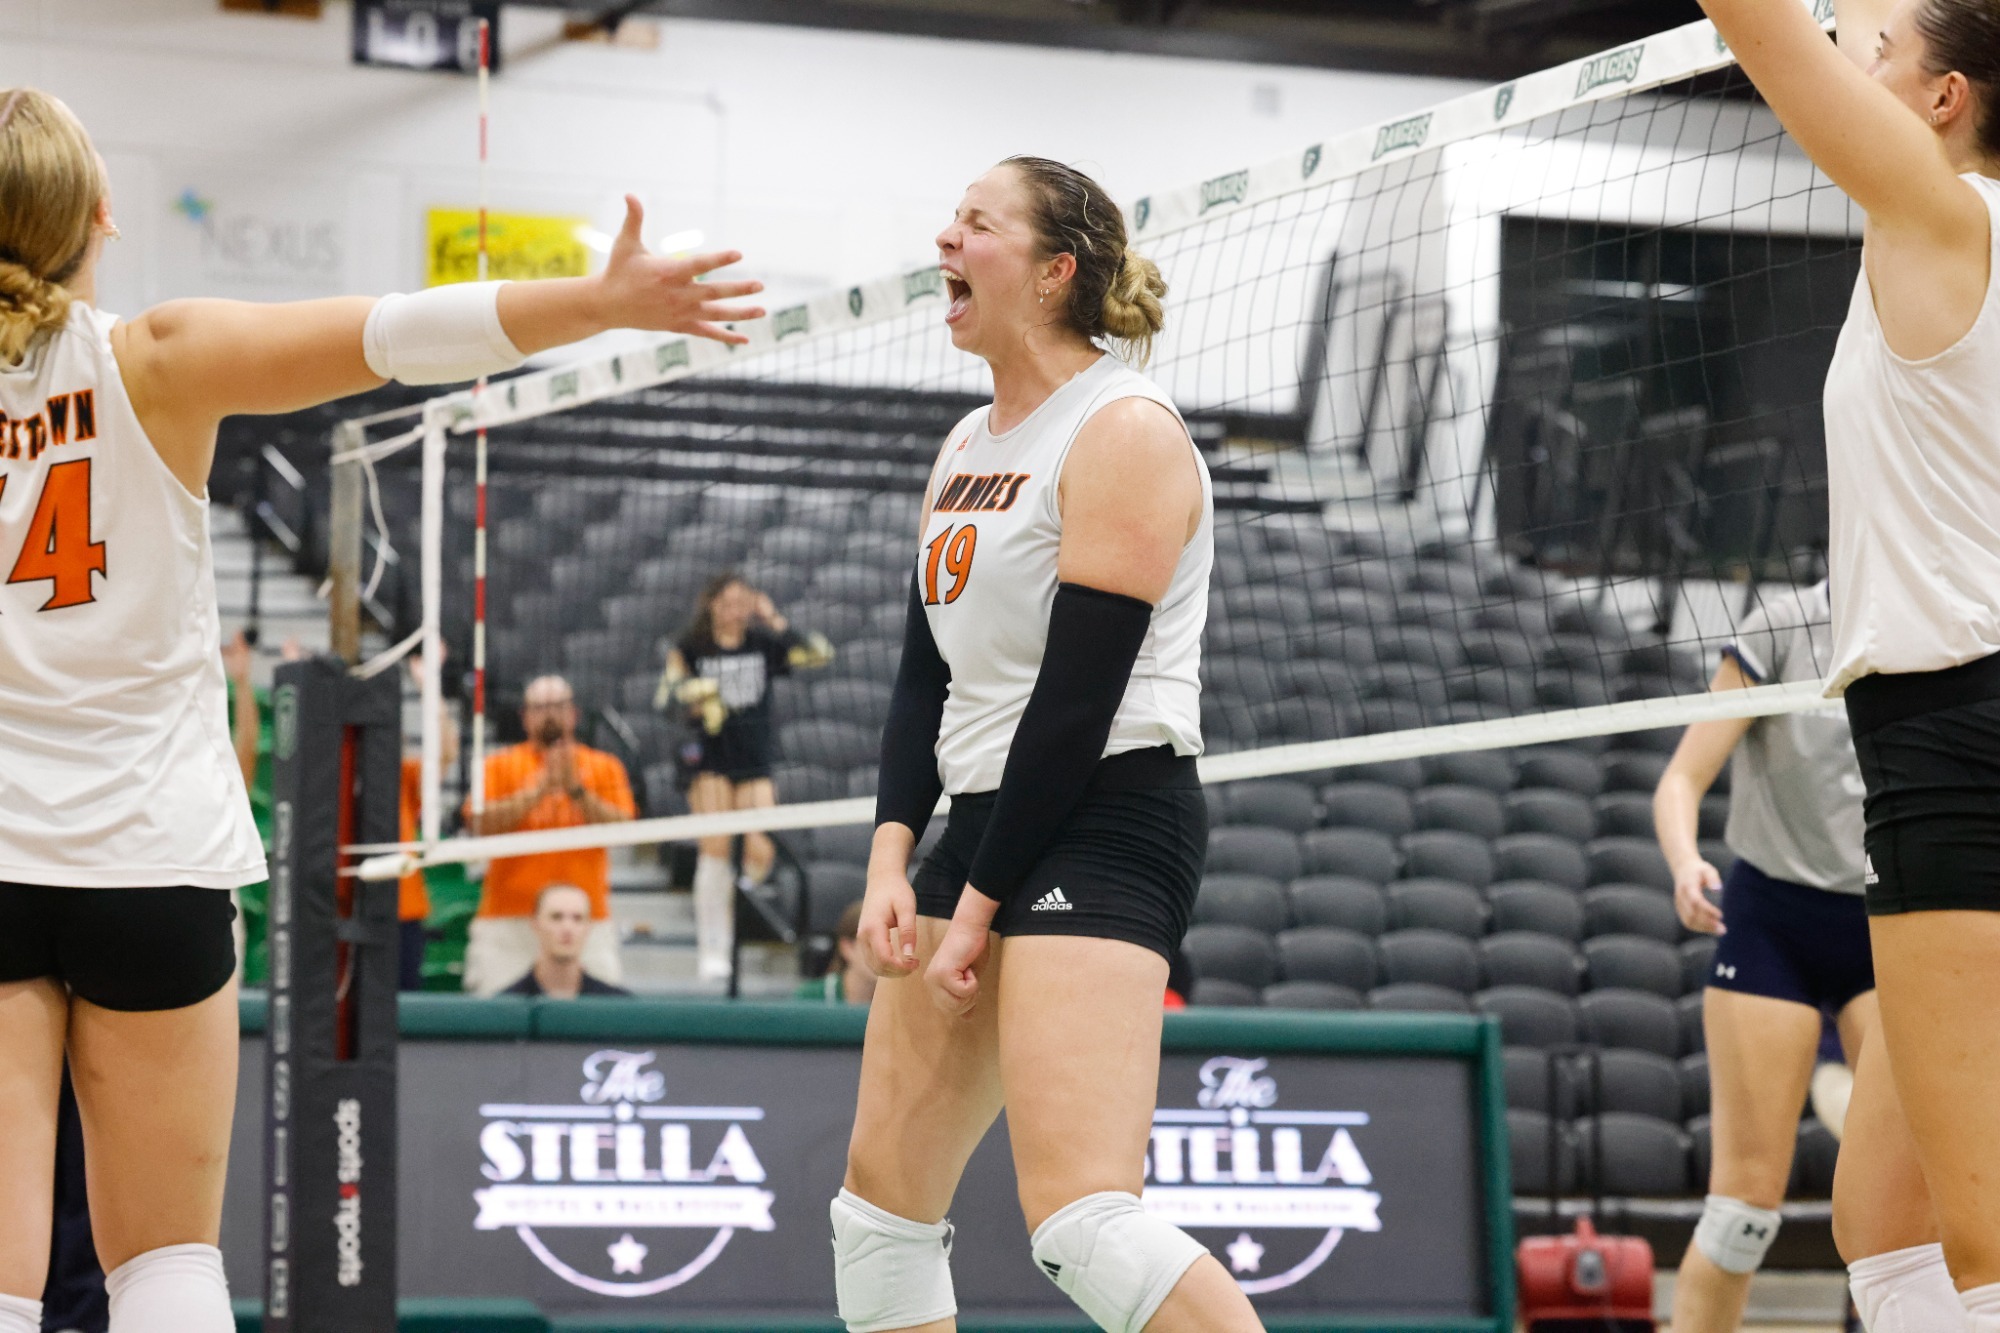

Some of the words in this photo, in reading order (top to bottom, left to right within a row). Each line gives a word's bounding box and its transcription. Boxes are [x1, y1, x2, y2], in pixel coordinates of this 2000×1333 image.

[925, 522, 977, 606] 19
[1031, 901, 1073, 912] adidas
[580, 1049, 666, 1104] The
[1197, 1055, 1278, 1109] The
[479, 1119, 767, 1183] STELLA
[1143, 1126, 1373, 1185] TELLA
